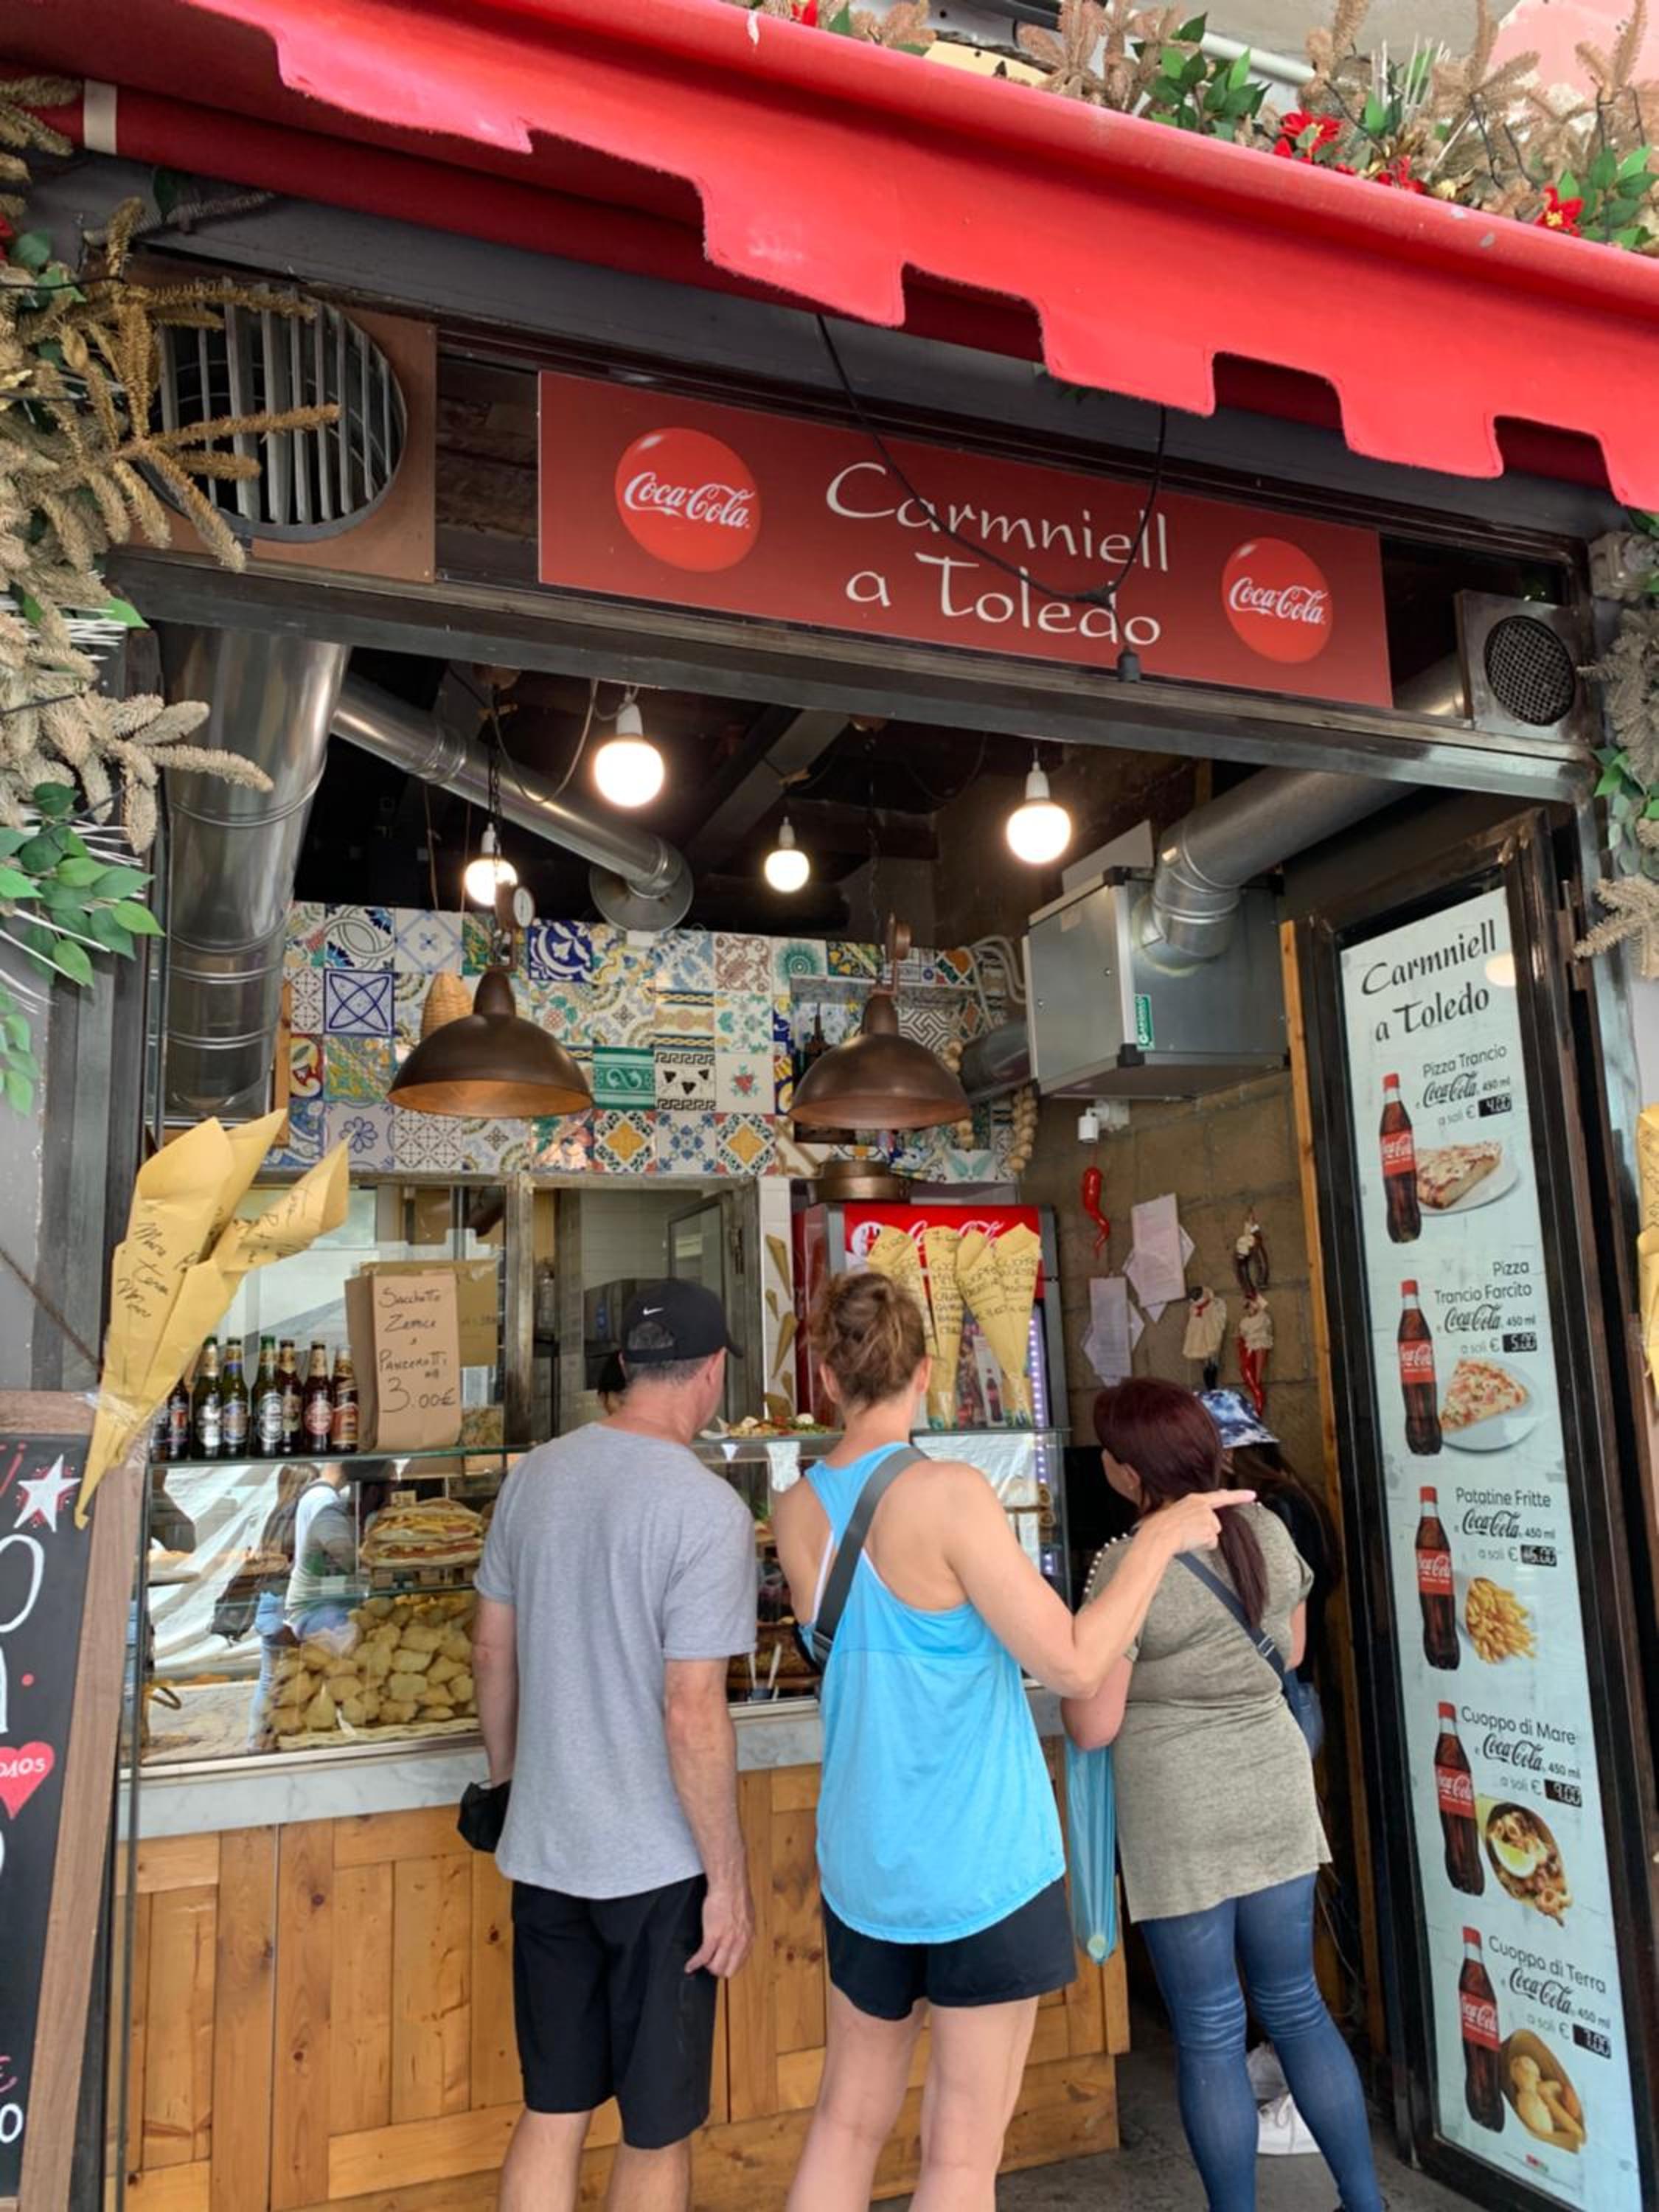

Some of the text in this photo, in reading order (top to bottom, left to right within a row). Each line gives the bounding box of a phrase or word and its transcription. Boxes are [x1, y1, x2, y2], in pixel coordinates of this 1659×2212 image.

[625, 471, 755, 529] Coca-Cola
[826, 461, 1169, 573] Carmniell
[846, 552, 1161, 646] a Toledo
[1229, 577, 1327, 625] Coca-Cola
[1361, 919, 1496, 995] Carmniell
[1375, 981, 1489, 1042] a Toledo
[1422, 1044, 1507, 1078] Pizza Trancio
[1466, 1104, 1475, 1119] €
[1492, 1262, 1529, 1276] Pizza
[1434, 1283, 1532, 1304] Trancio Farcito
[1489, 1338, 1500, 1352] €
[1455, 1487, 1551, 1508] Patatine Fritte
[1525, 1527, 1542, 1538] 450
[1544, 1528, 1556, 1540] ml
[1508, 1547, 1518, 1562] €
[1461, 1705, 1576, 1745] Cuoppo di Mare
[1548, 1762, 1566, 1775] 450
[1568, 1767, 1581, 1778] ml
[1531, 1779, 1542, 1795] €
[1489, 1935, 1606, 1994] Cuoppo di Terra
[1559, 2022, 1569, 2039] €
